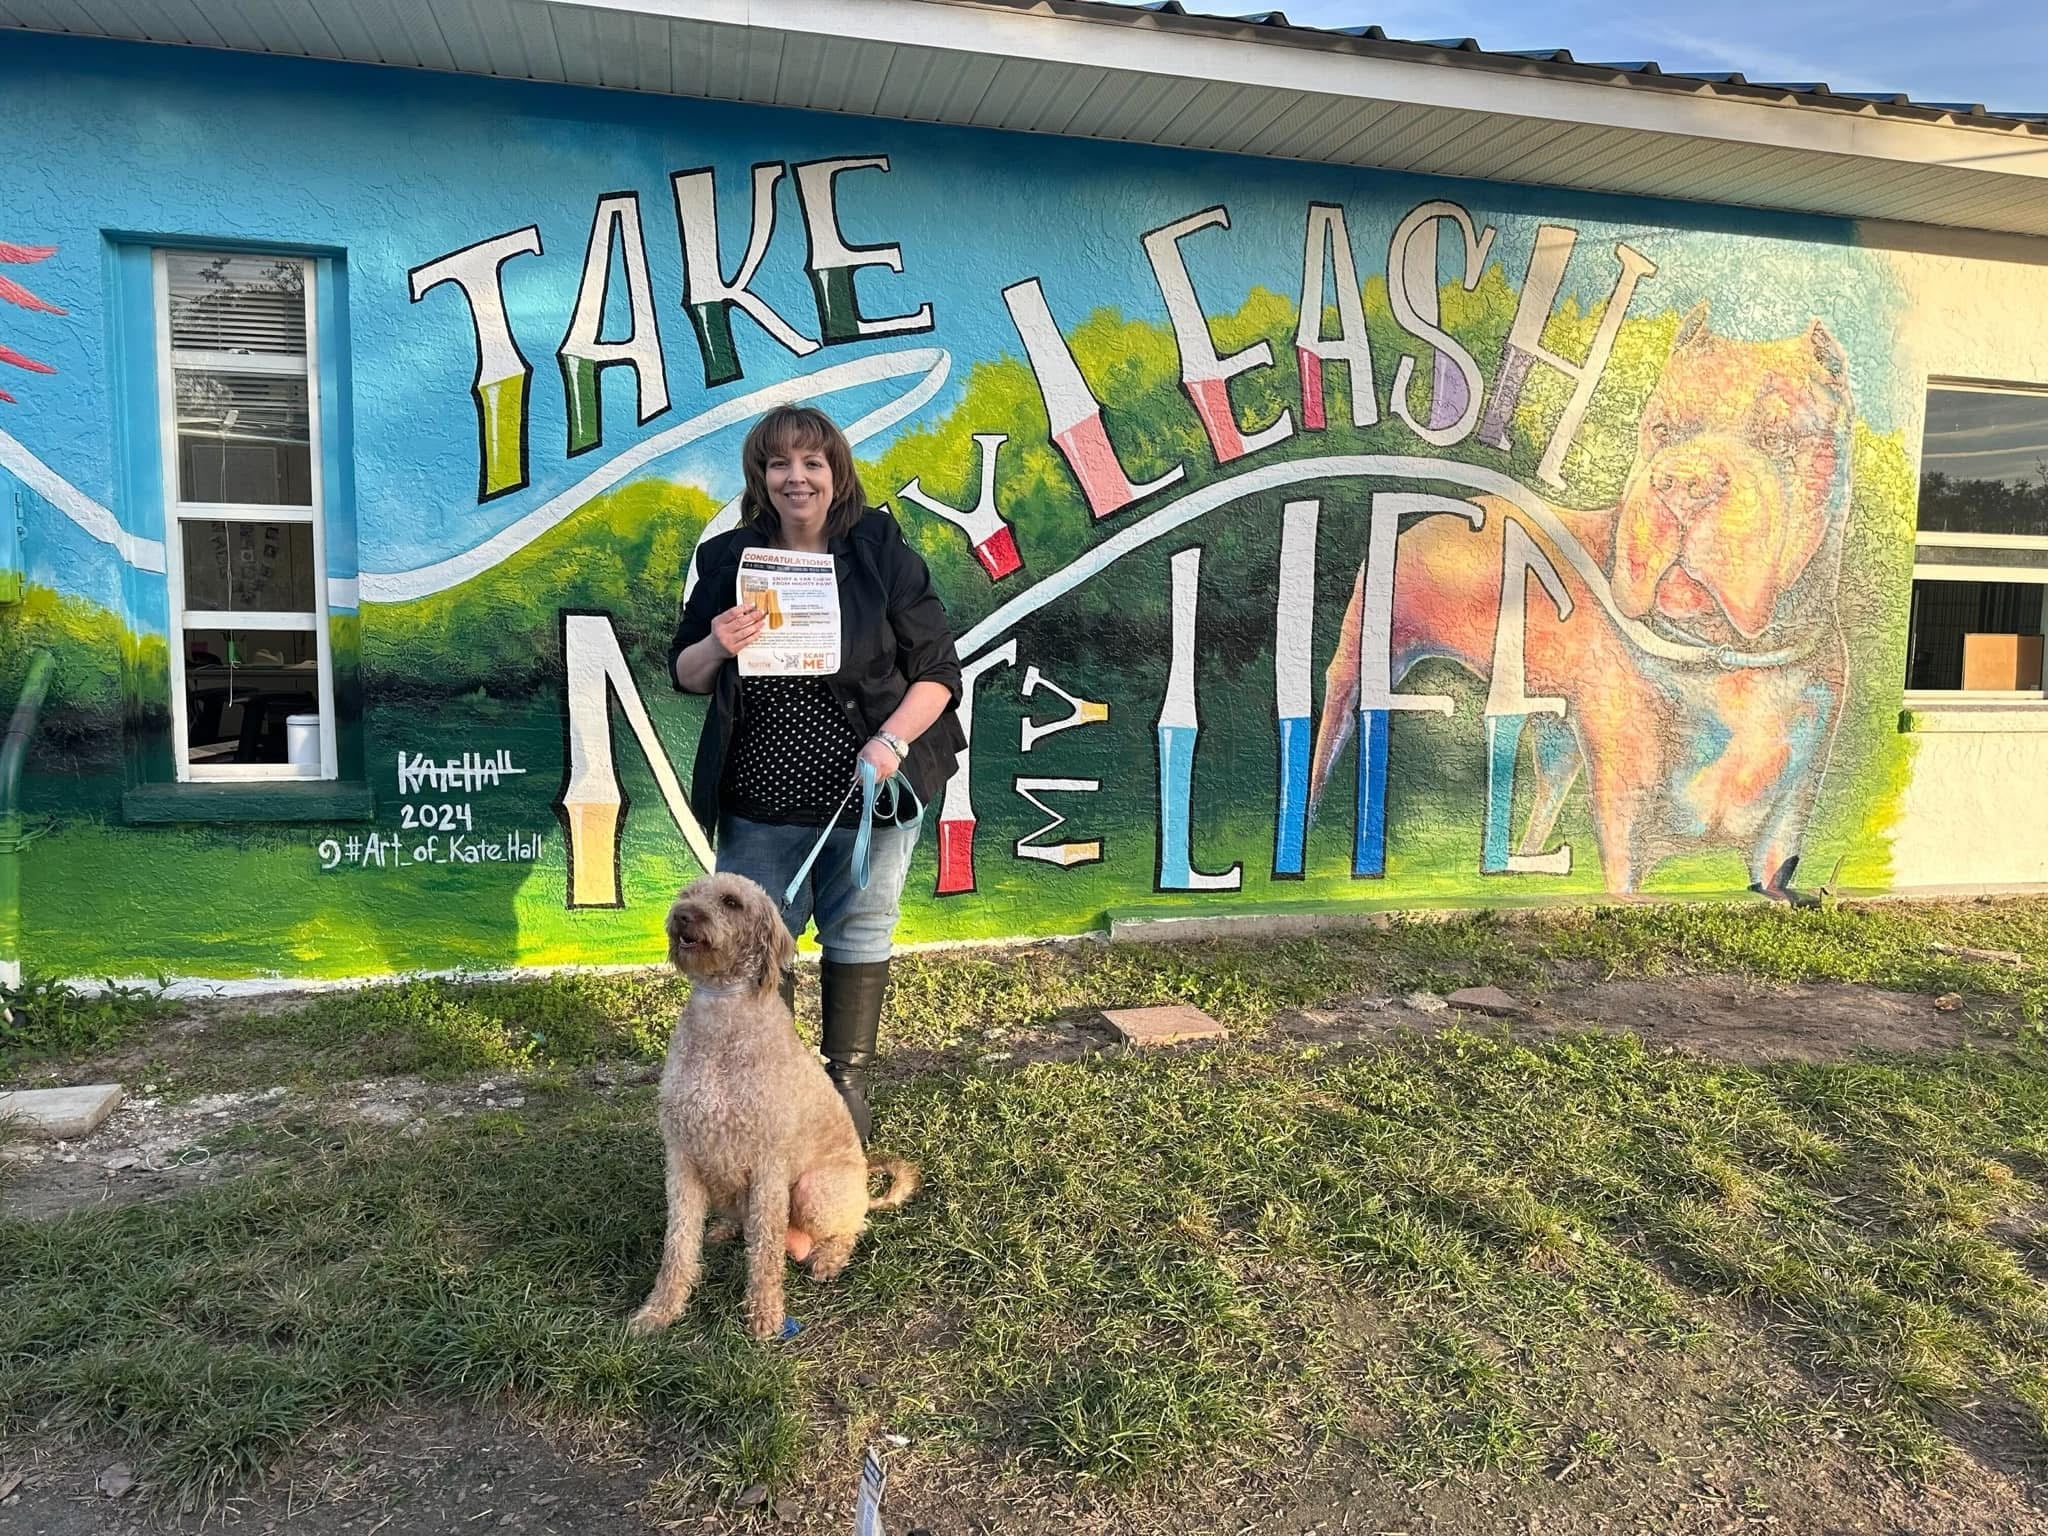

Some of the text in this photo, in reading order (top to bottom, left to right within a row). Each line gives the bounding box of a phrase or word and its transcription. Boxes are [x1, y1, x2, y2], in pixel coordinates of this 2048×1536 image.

[408, 154, 935, 504] TAKE
[877, 200, 1658, 584] Y LEASH
[400, 803, 473, 831] 2024
[803, 659, 825, 669] ME
[1015, 665, 1111, 868] MY
[1153, 491, 1574, 893] LIFE
